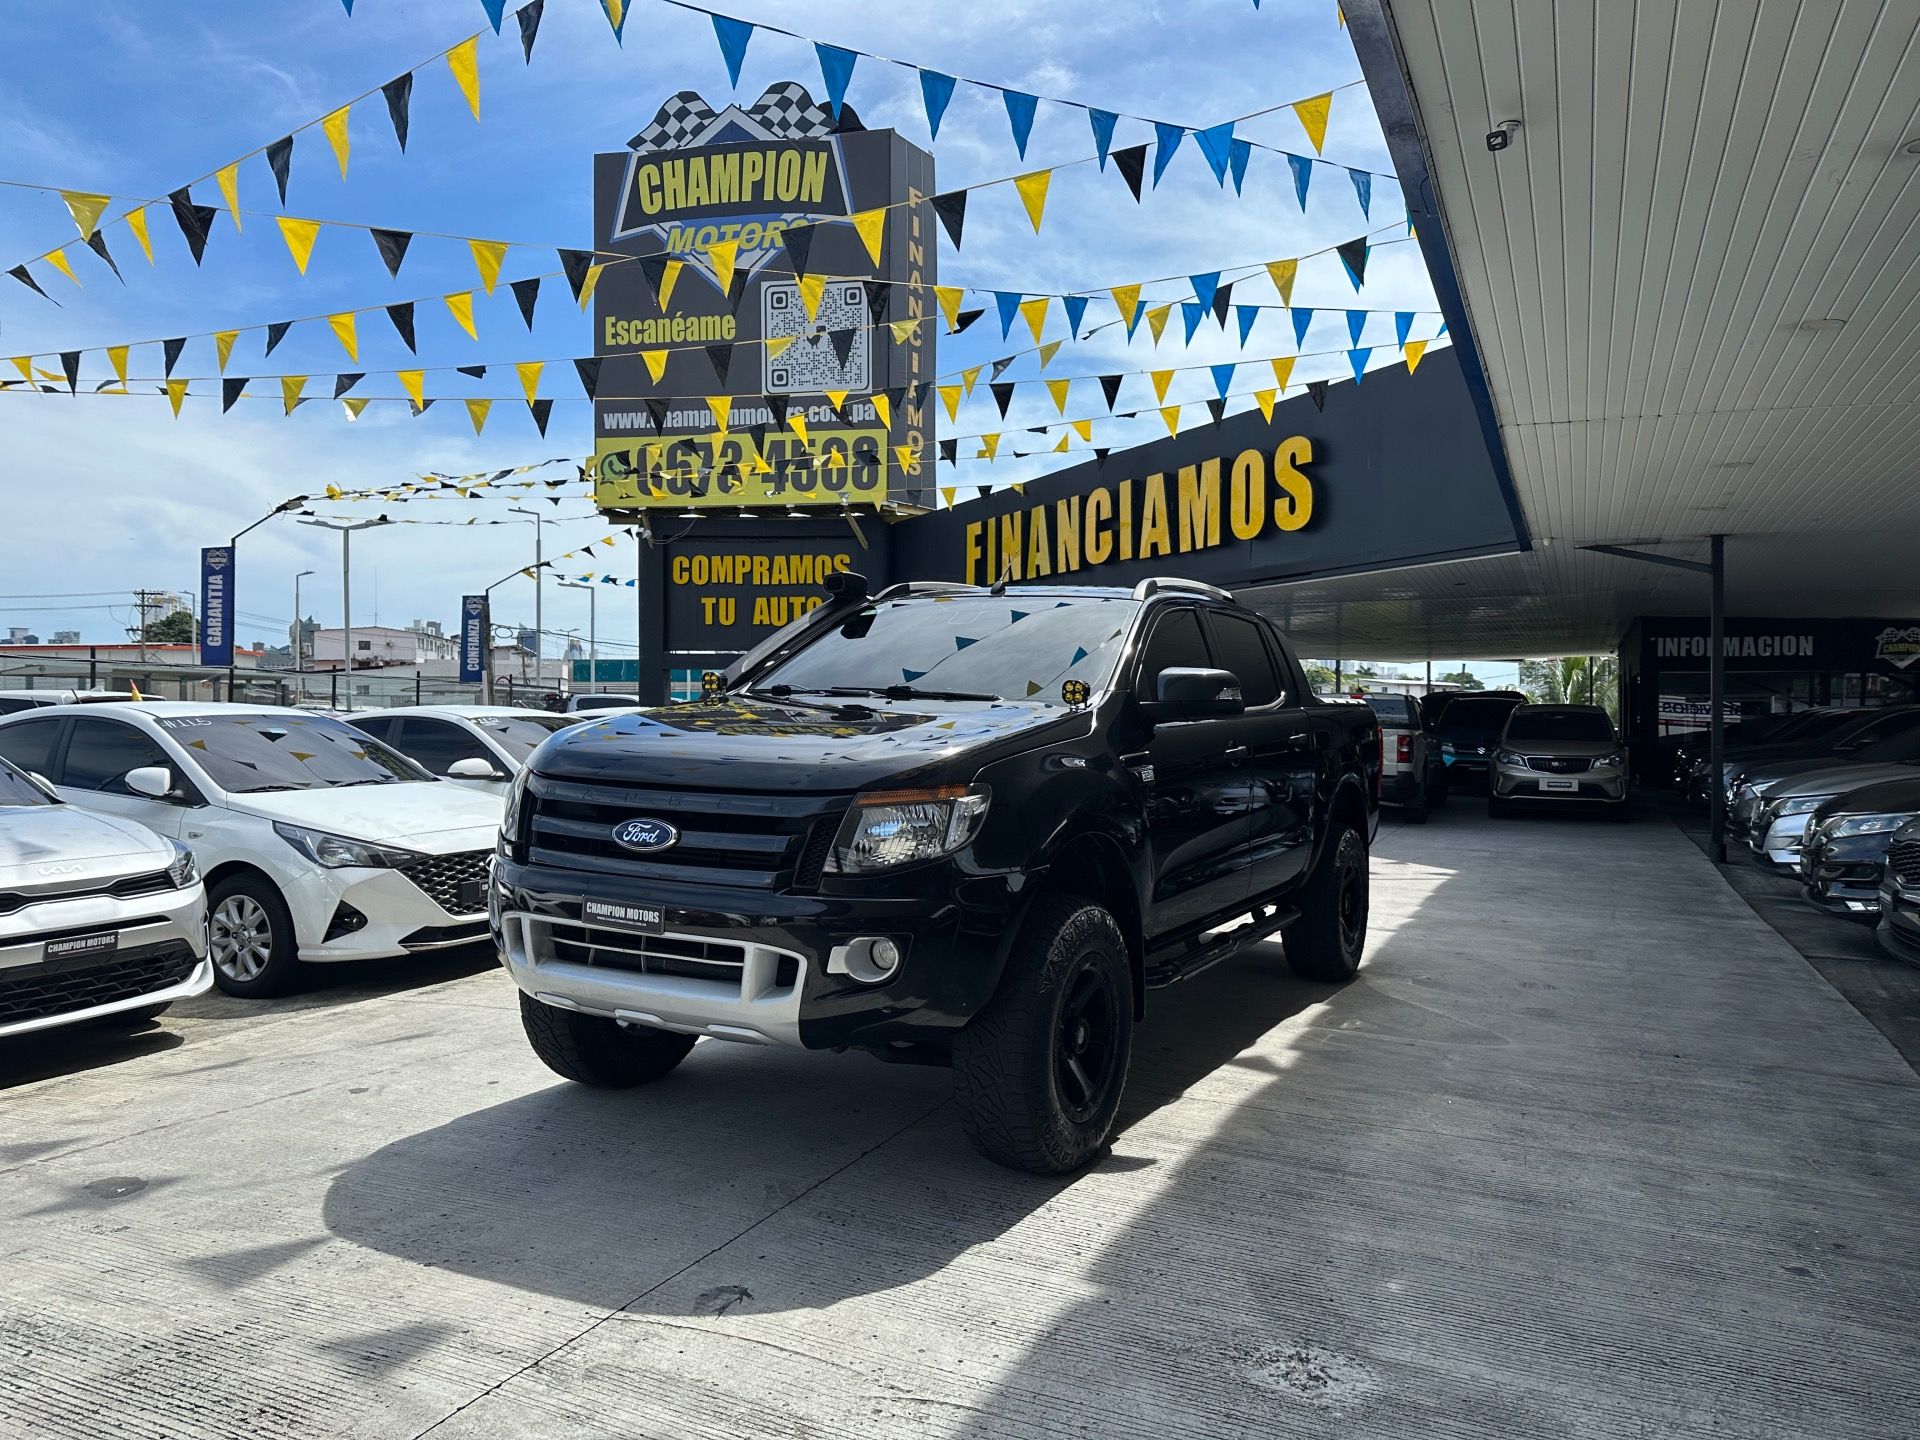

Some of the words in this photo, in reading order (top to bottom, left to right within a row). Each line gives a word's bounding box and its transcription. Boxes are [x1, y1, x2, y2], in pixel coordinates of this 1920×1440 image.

[638, 150, 828, 214] CHAMPION
[605, 311, 736, 346] Escanéame
[965, 435, 1313, 585] FINANCIAMOS
[672, 553, 851, 586] COMPRAMOS
[206, 574, 223, 646] GARANTIA
[701, 597, 736, 626] TU
[467, 618, 480, 671] CONFIANZA
[623, 822, 660, 843] Ford
[586, 902, 626, 918] CHAMPION
[626, 907, 660, 923] MOTORS
[48, 940, 86, 953] CHAMPION
[86, 935, 116, 947] MOTORS
